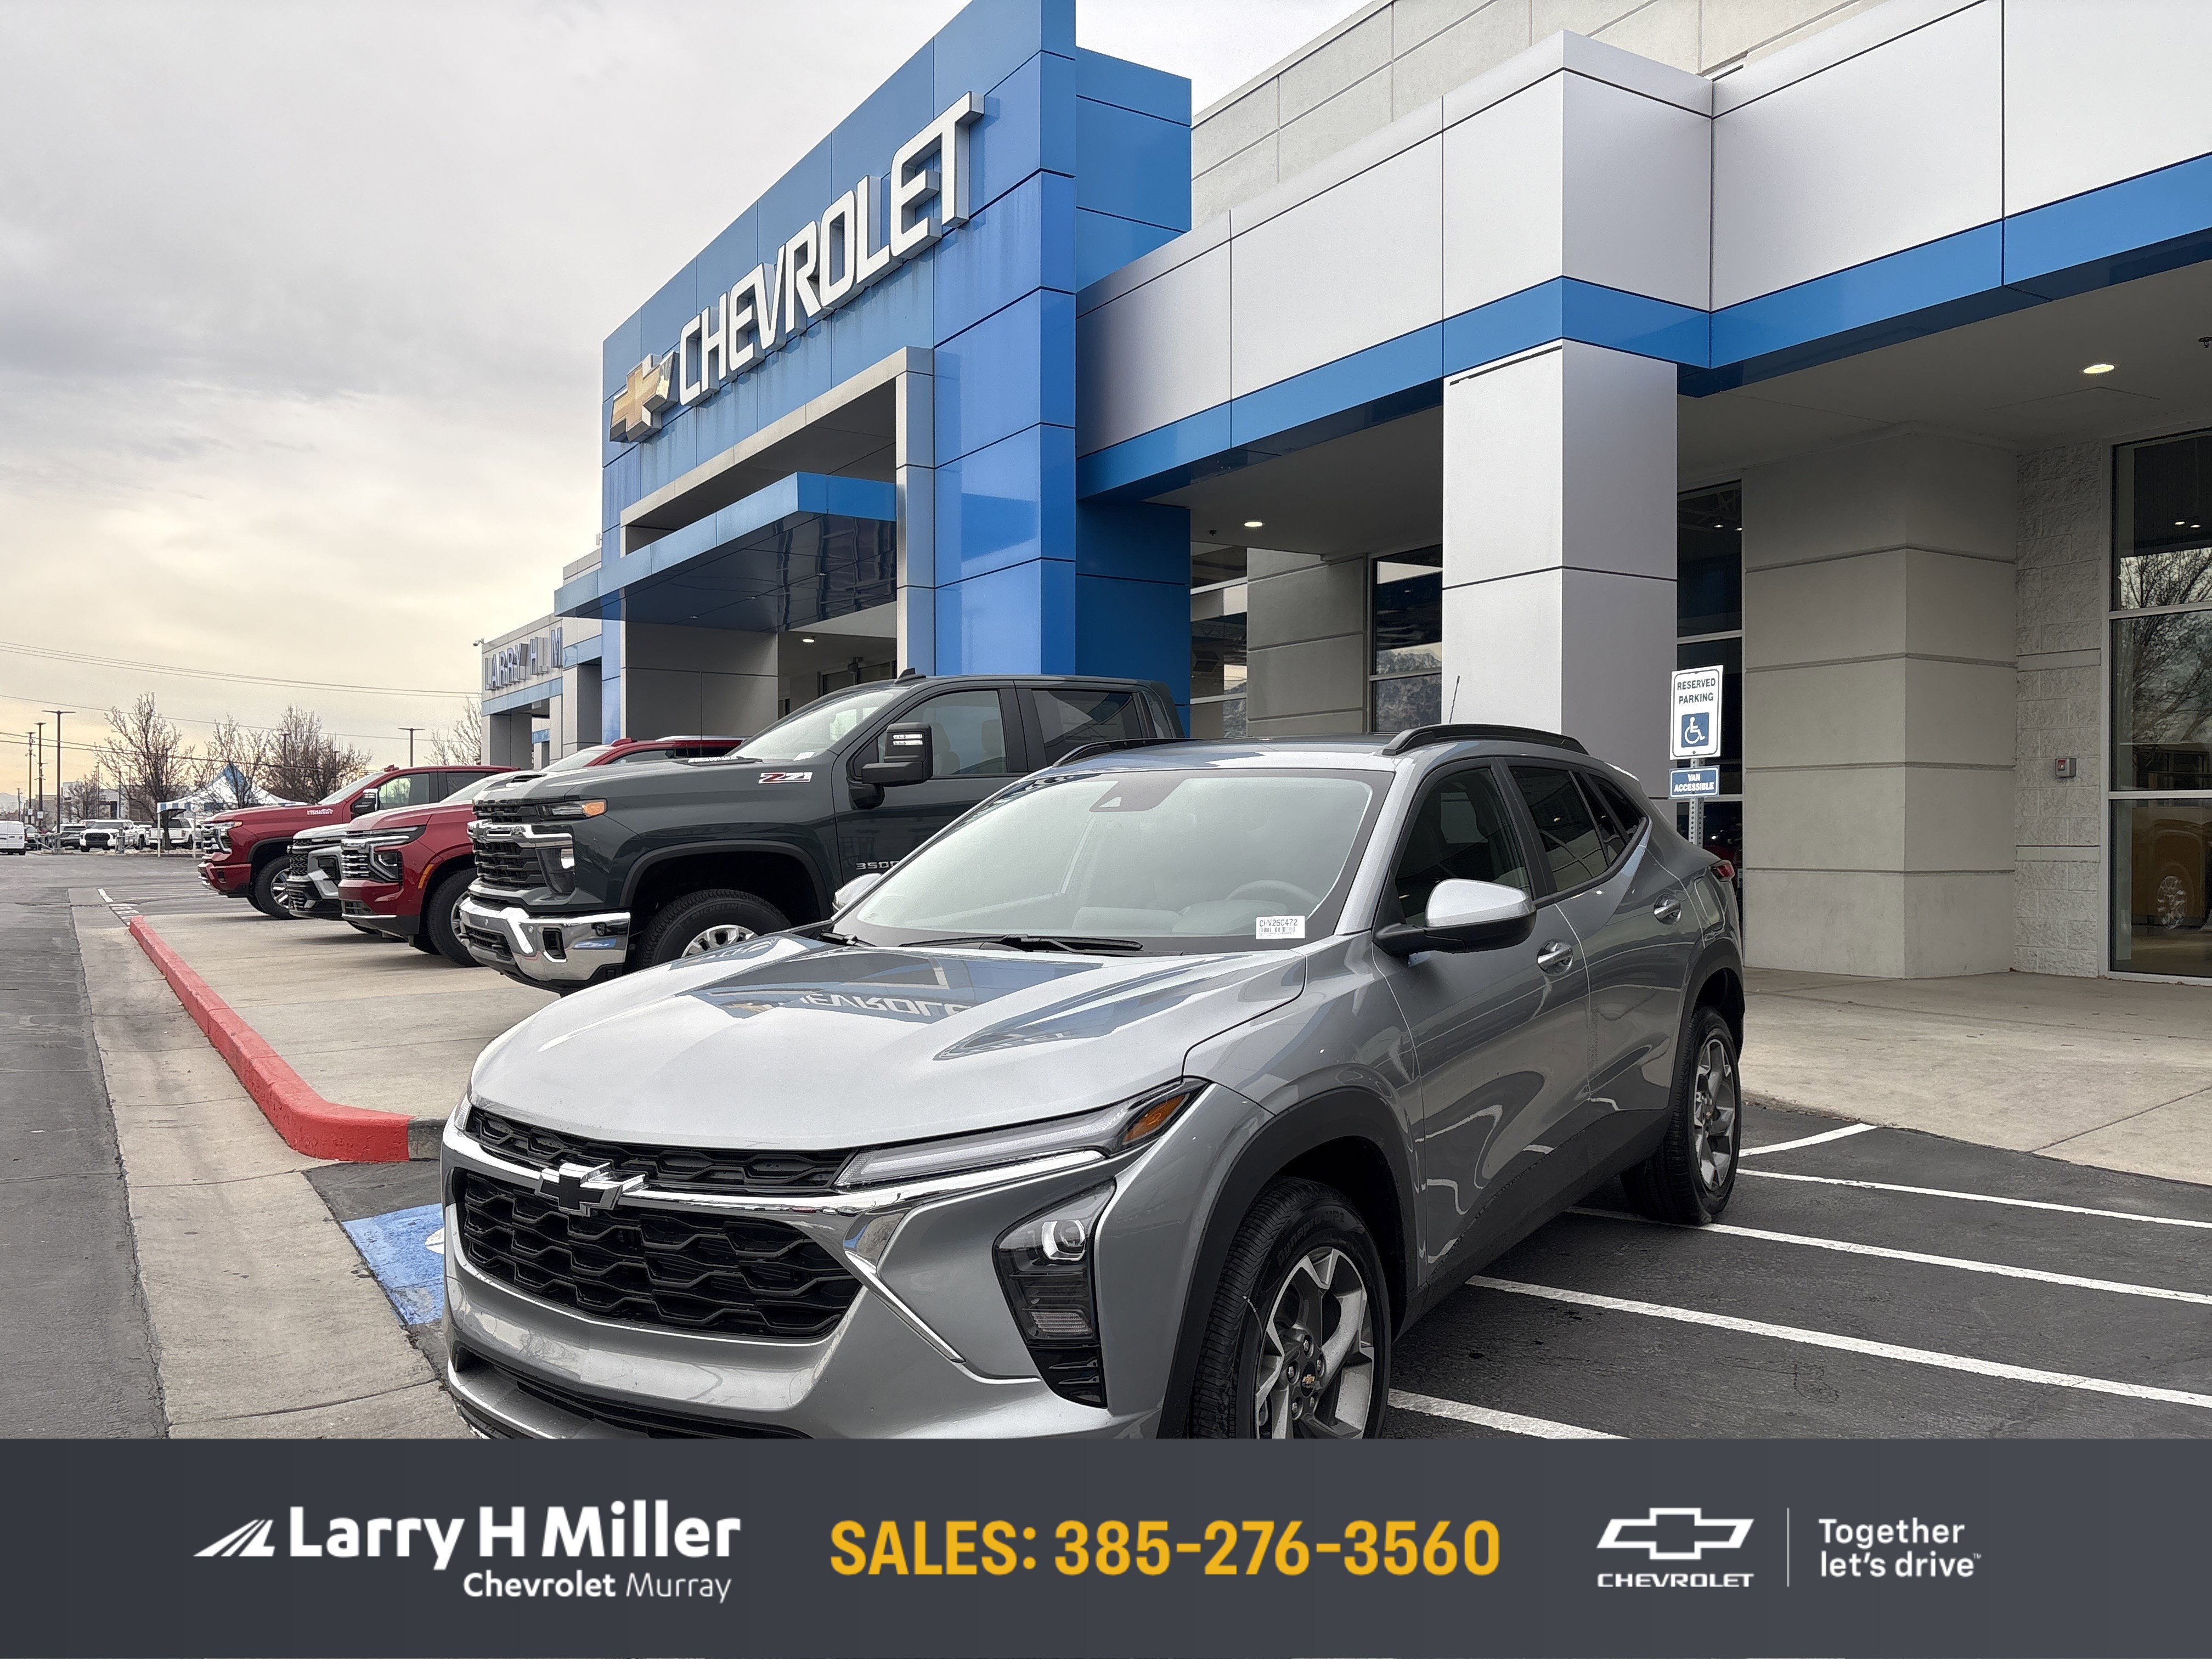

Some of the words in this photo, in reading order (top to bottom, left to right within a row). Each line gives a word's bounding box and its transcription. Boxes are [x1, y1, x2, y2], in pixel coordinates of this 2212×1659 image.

[678, 91, 984, 407] CHEVROLET
[485, 644, 525, 690] LARRY
[1677, 678, 1716, 691] RESERVED
[1679, 692, 1714, 704] PARKING
[759, 772, 813, 784] Z71
[1688, 773, 1701, 782] VAN
[1674, 781, 1714, 792] ACCESSIBLE
[1259, 919, 1298, 927] CHV260472
